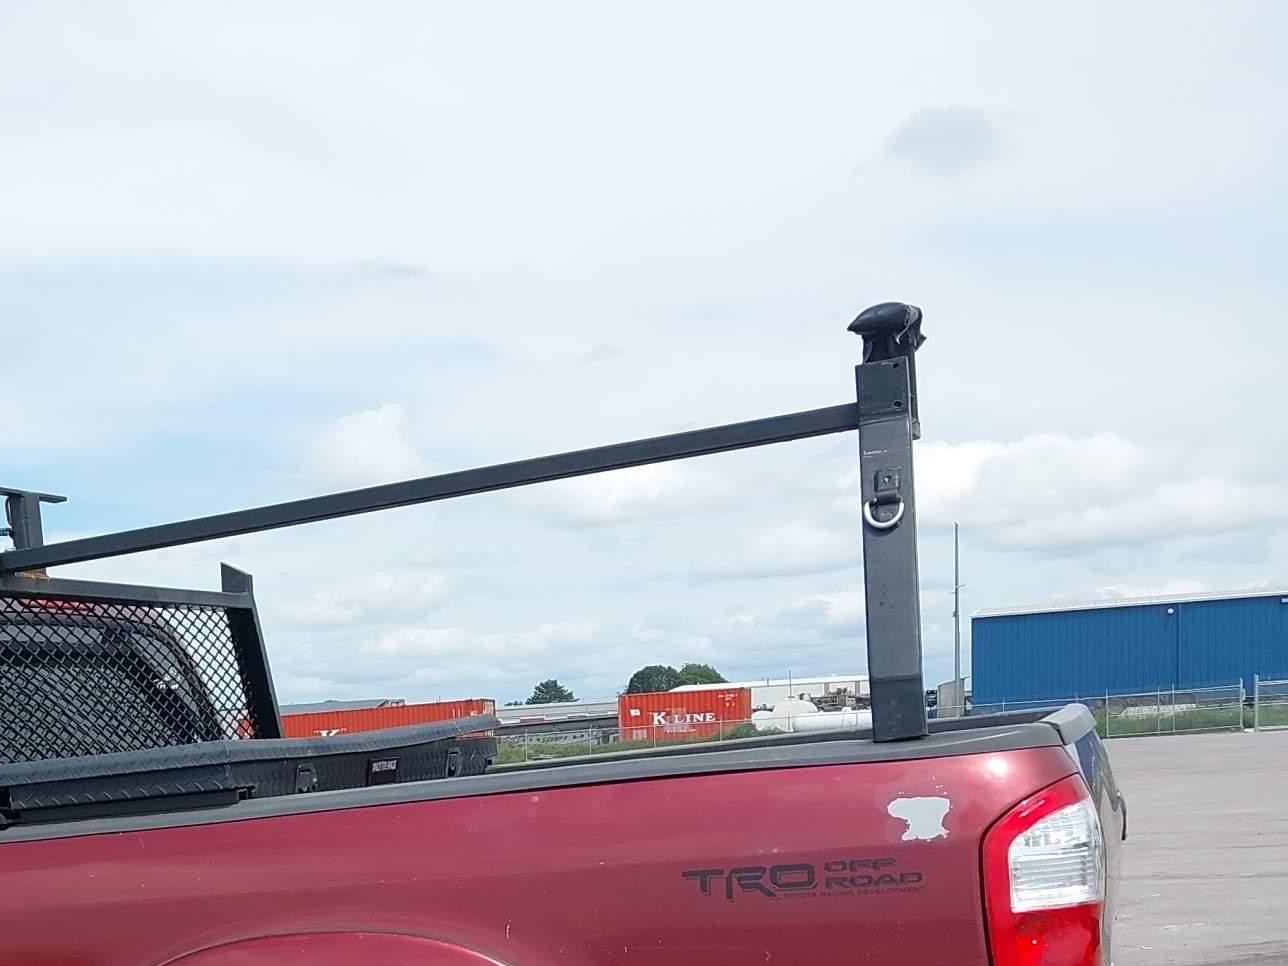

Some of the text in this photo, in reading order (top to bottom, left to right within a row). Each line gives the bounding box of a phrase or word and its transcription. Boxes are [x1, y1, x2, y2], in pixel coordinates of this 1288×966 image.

[674, 712, 716, 723] LINE
[824, 858, 897, 873] OFF
[824, 872, 923, 888] ROAD
